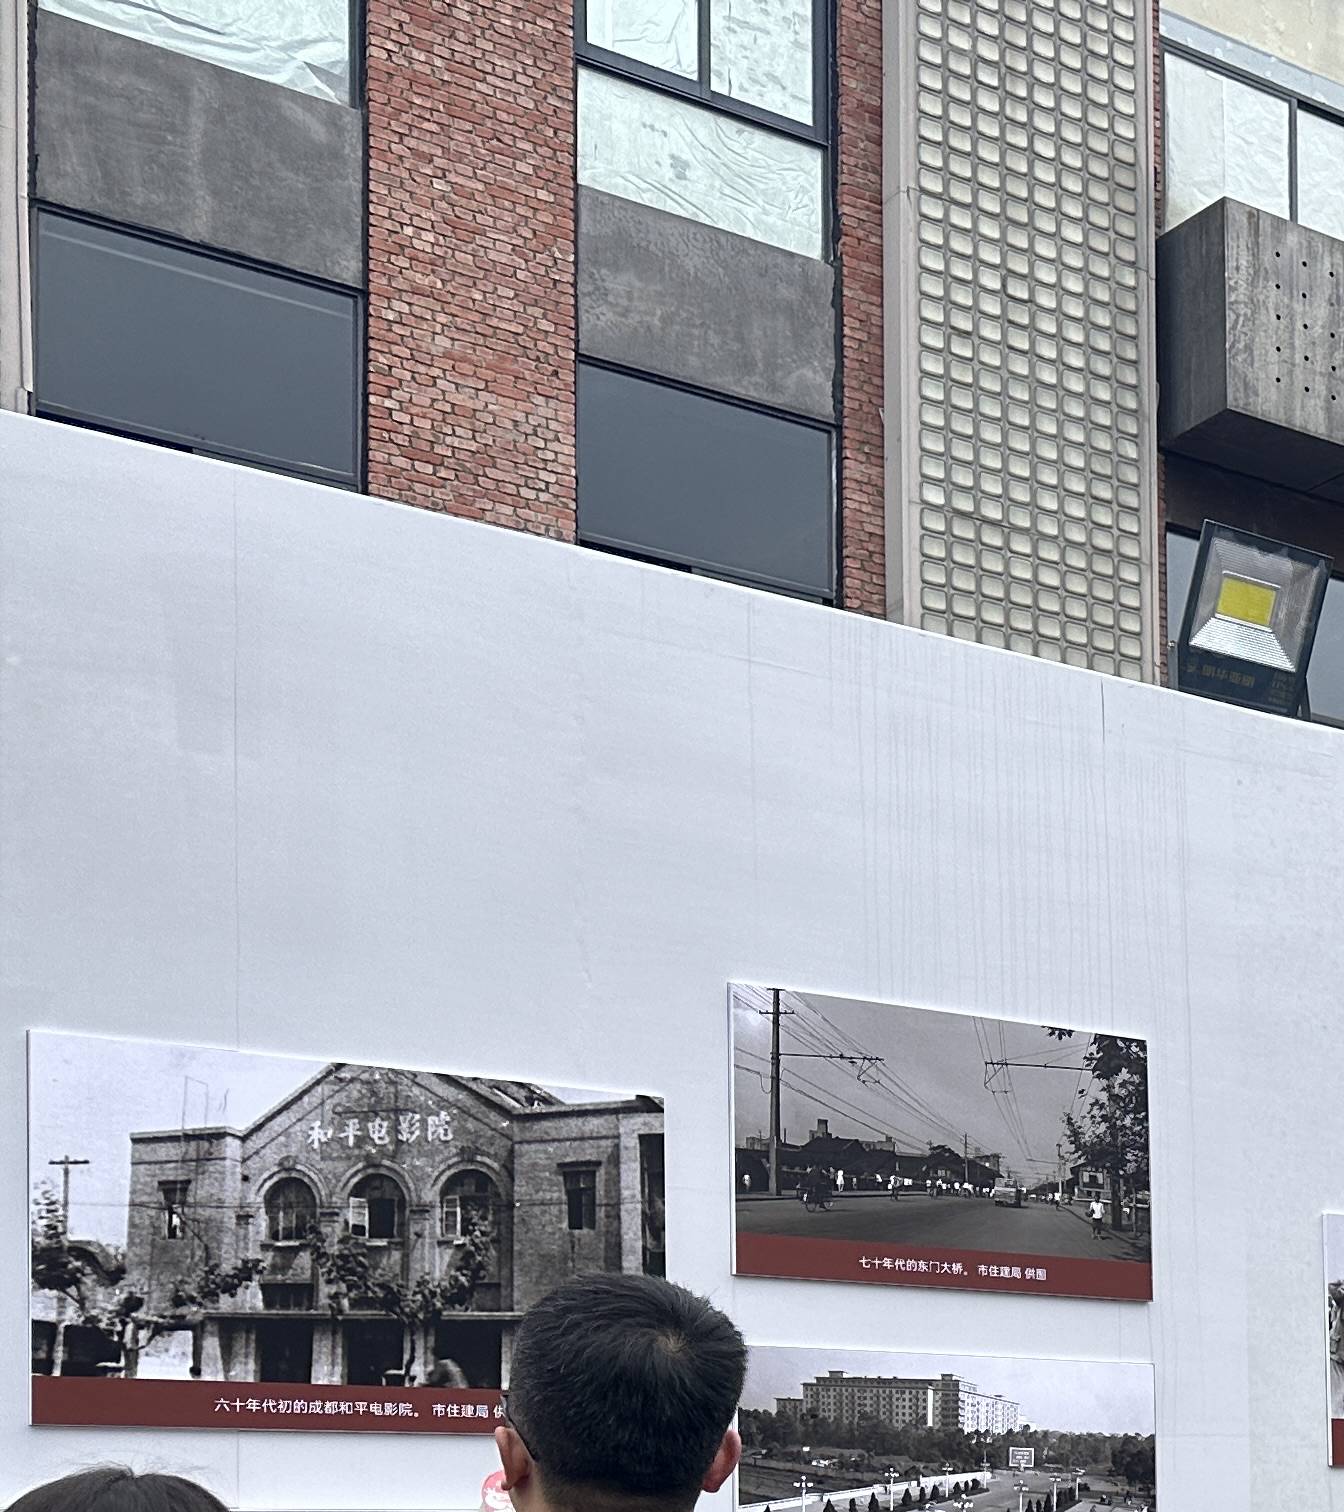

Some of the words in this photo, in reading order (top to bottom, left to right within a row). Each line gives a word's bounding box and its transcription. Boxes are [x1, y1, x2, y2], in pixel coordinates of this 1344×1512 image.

[306, 1110, 454, 1150] 和平电影院
[858, 1256, 968, 1277] 七十年代的东门大桥。
[214, 1397, 421, 1418] 六十年代初的成都和平电影院。
[432, 1403, 489, 1419] 市住建局
